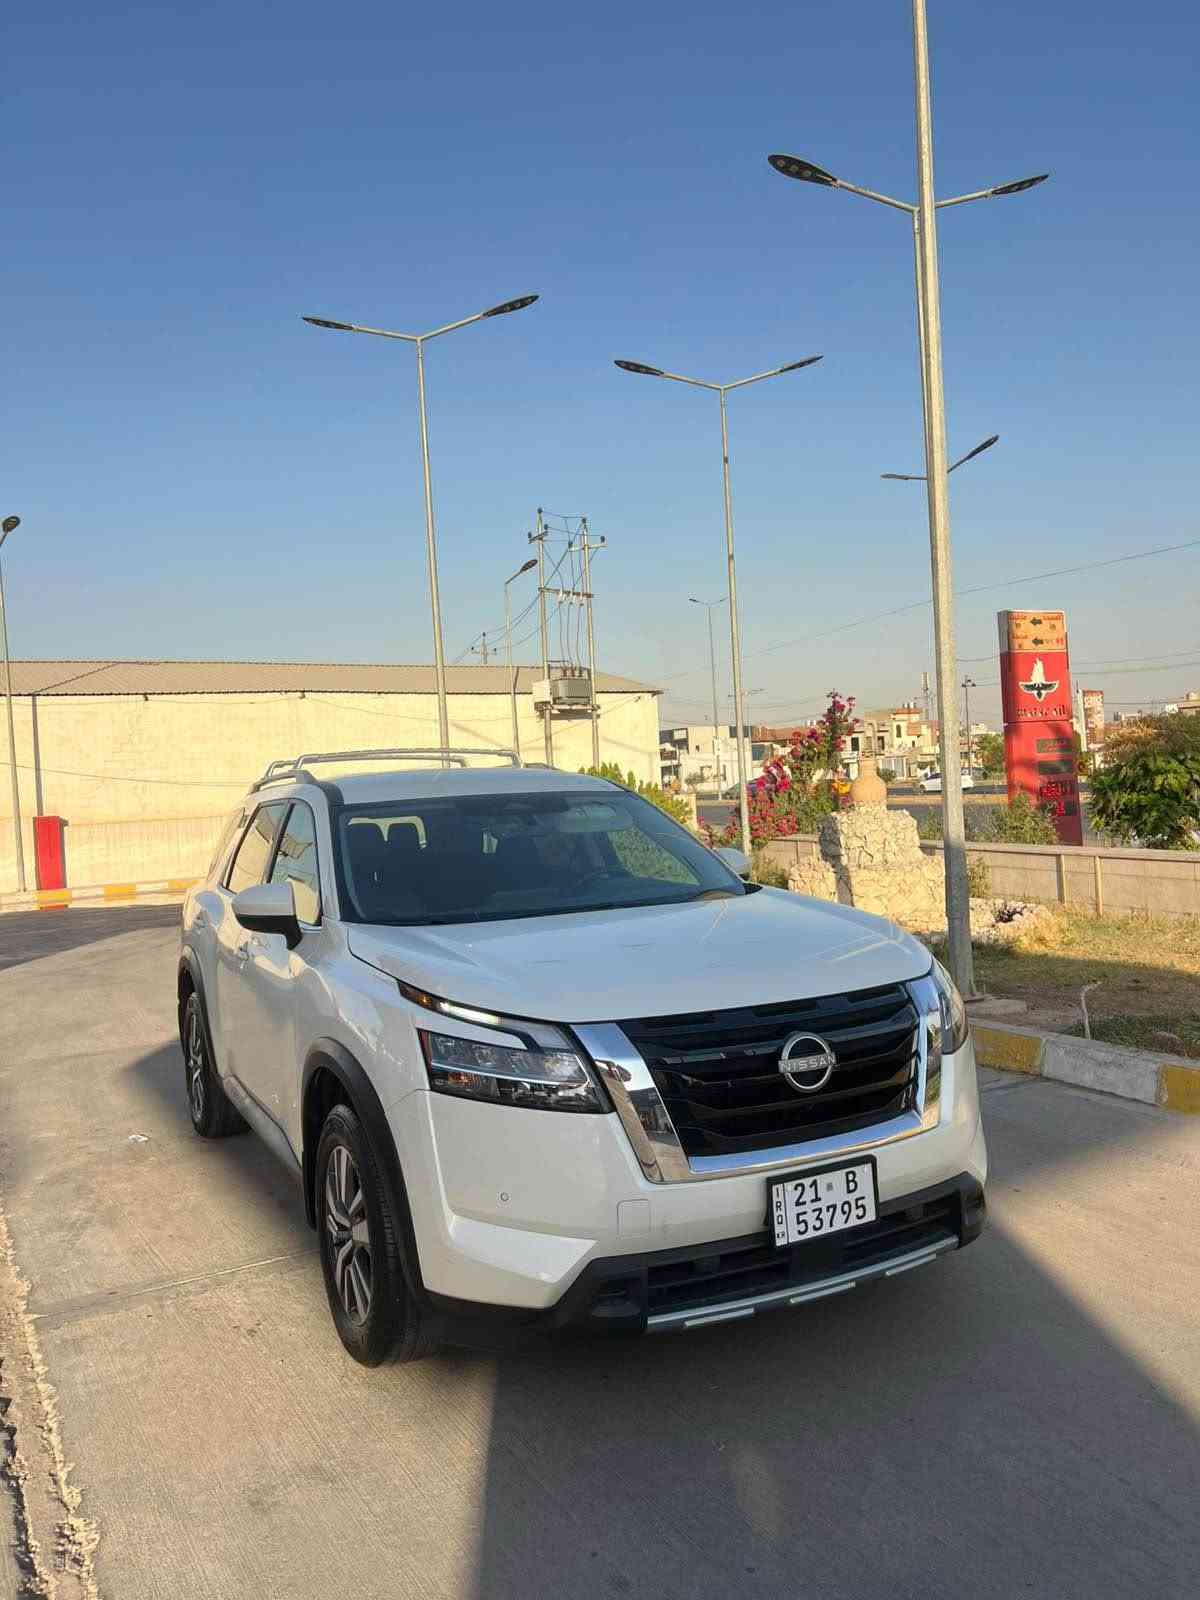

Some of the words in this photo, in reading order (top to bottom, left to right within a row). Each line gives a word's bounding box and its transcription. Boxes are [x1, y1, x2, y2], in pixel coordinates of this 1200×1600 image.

[782, 1052, 835, 1074] NISSAN
[793, 1178, 822, 1207] 21
[844, 1170, 858, 1194] B
[795, 1196, 867, 1236] 53795
